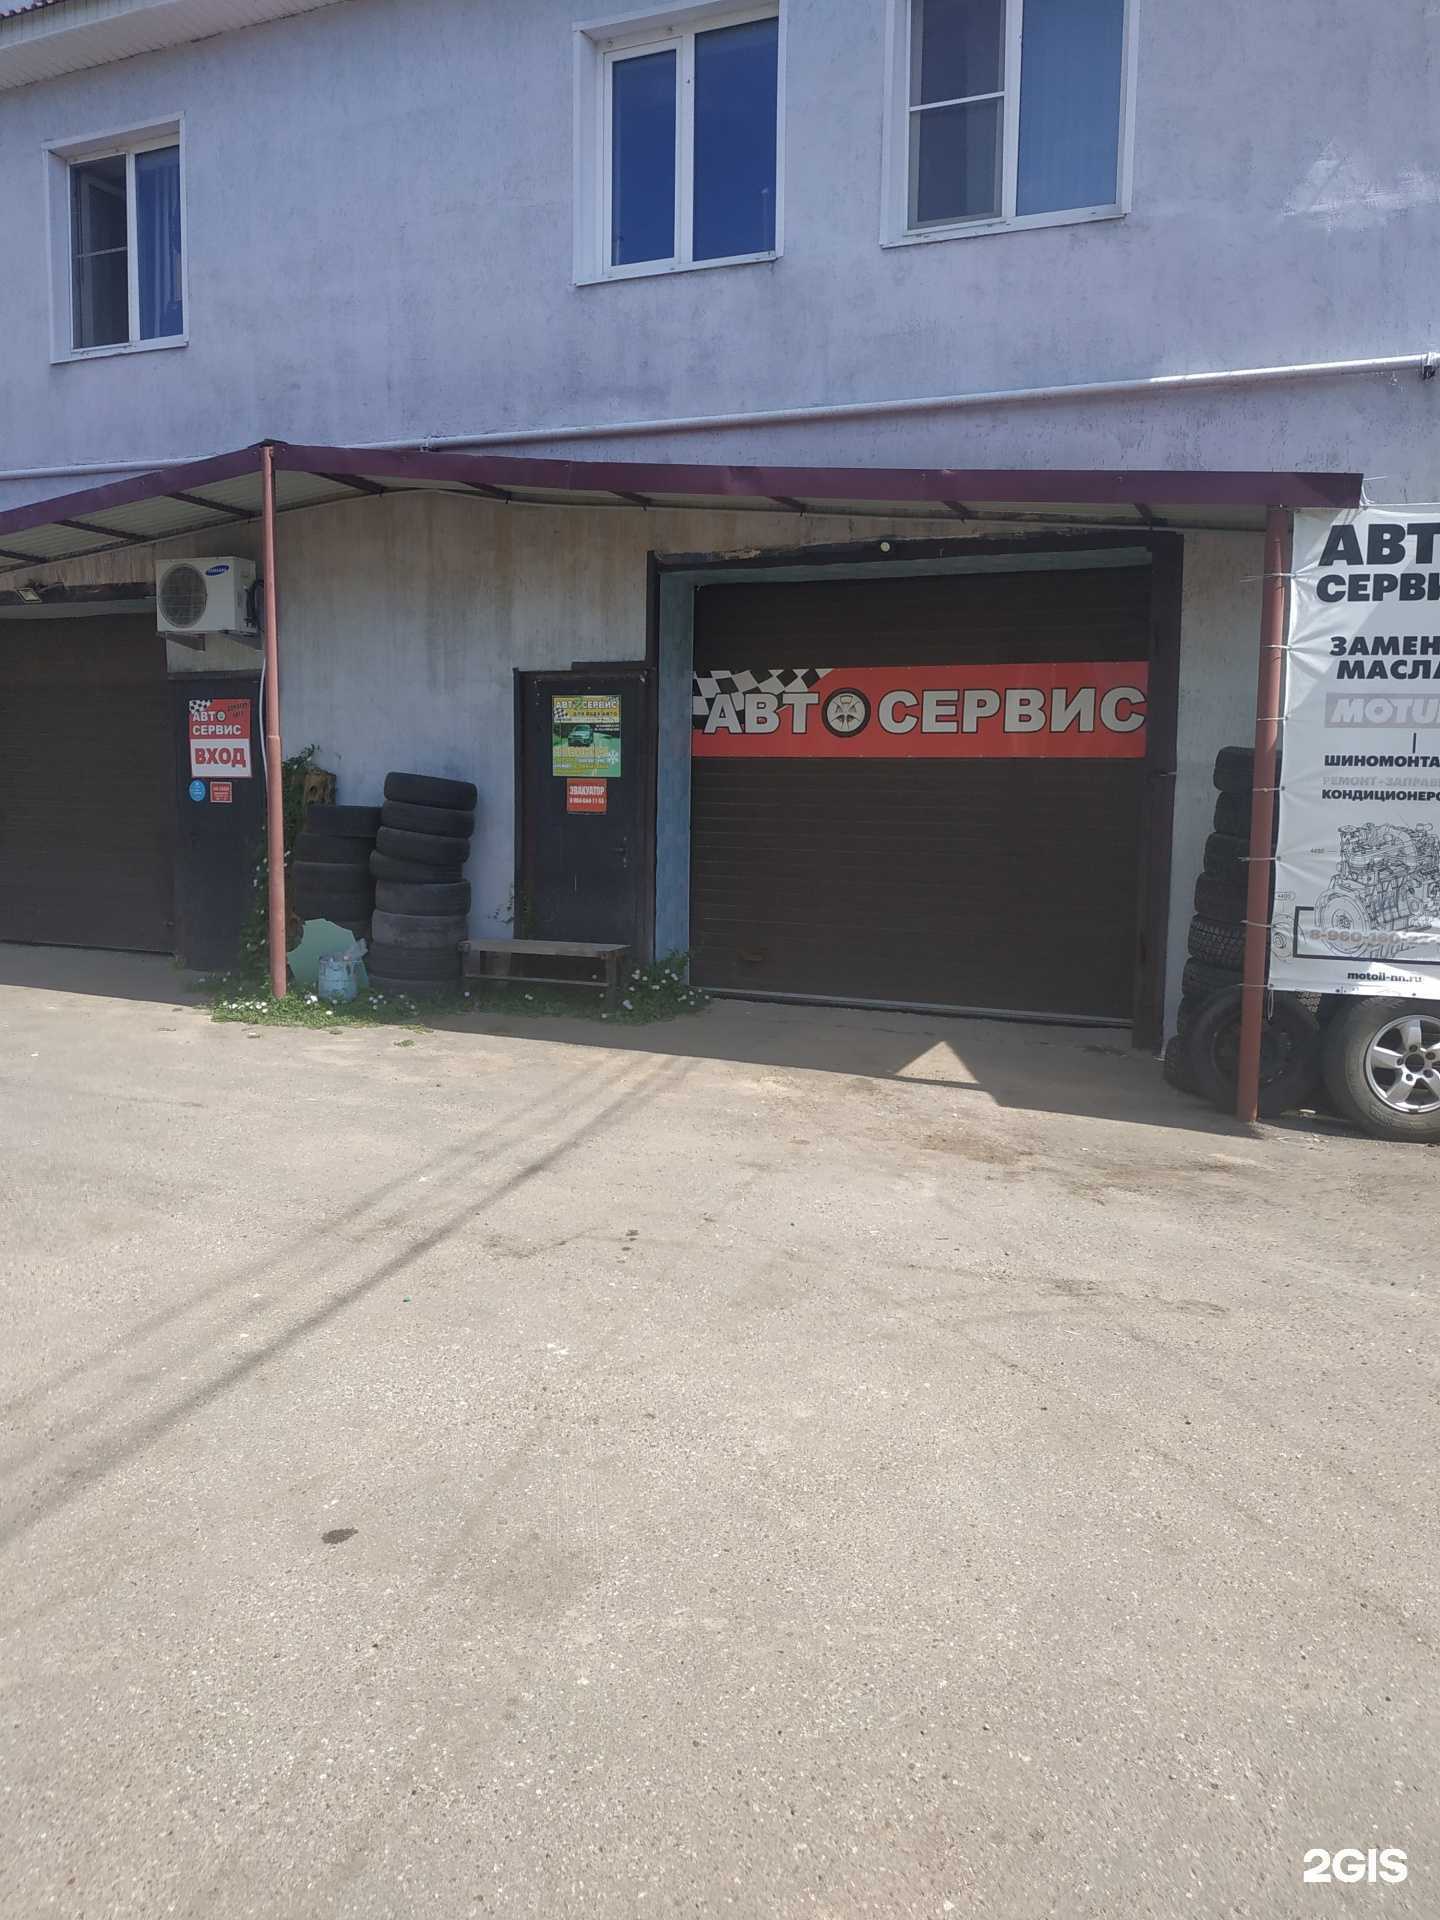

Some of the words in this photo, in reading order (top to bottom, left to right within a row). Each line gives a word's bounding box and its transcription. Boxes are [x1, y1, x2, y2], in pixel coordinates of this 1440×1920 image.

[1329, 635, 1440, 656] ЗАМЕН
[192, 711, 225, 722] АВТО
[1328, 698, 1440, 723] MOTU
[192, 724, 241, 735] СЕРВИС
[195, 747, 246, 768] ВХОД
[1324, 755, 1440, 768] ШИНОМОНТА
[569, 785, 605, 796] ЭВАКУАТОР
[1347, 972, 1422, 983] motoil-nn.ru
